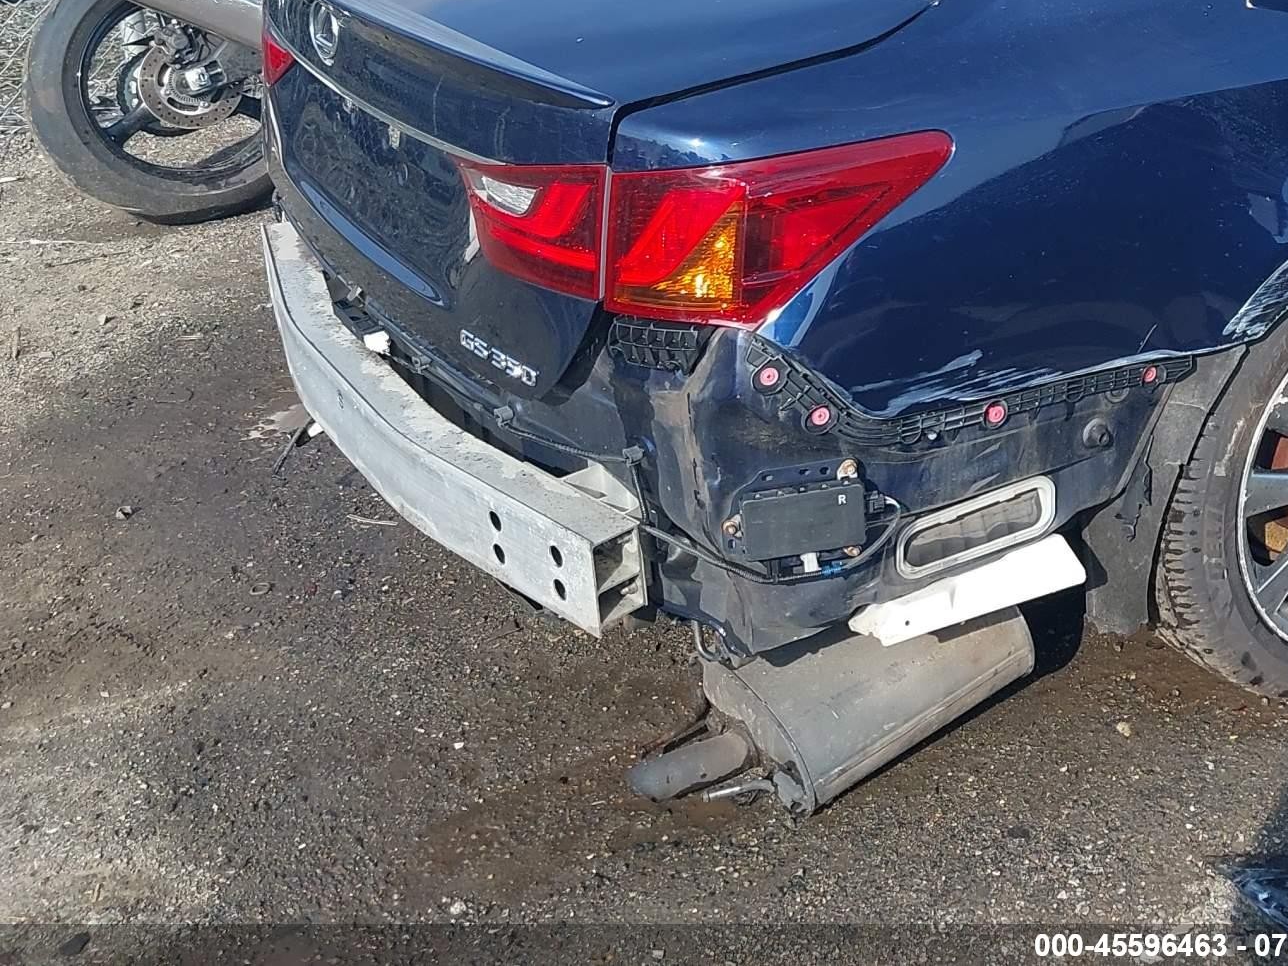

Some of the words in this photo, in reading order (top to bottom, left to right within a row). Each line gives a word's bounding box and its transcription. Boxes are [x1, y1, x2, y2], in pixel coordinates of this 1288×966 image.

[460, 329, 489, 361] GS
[491, 347, 538, 387] 350
[838, 494, 847, 505] R
